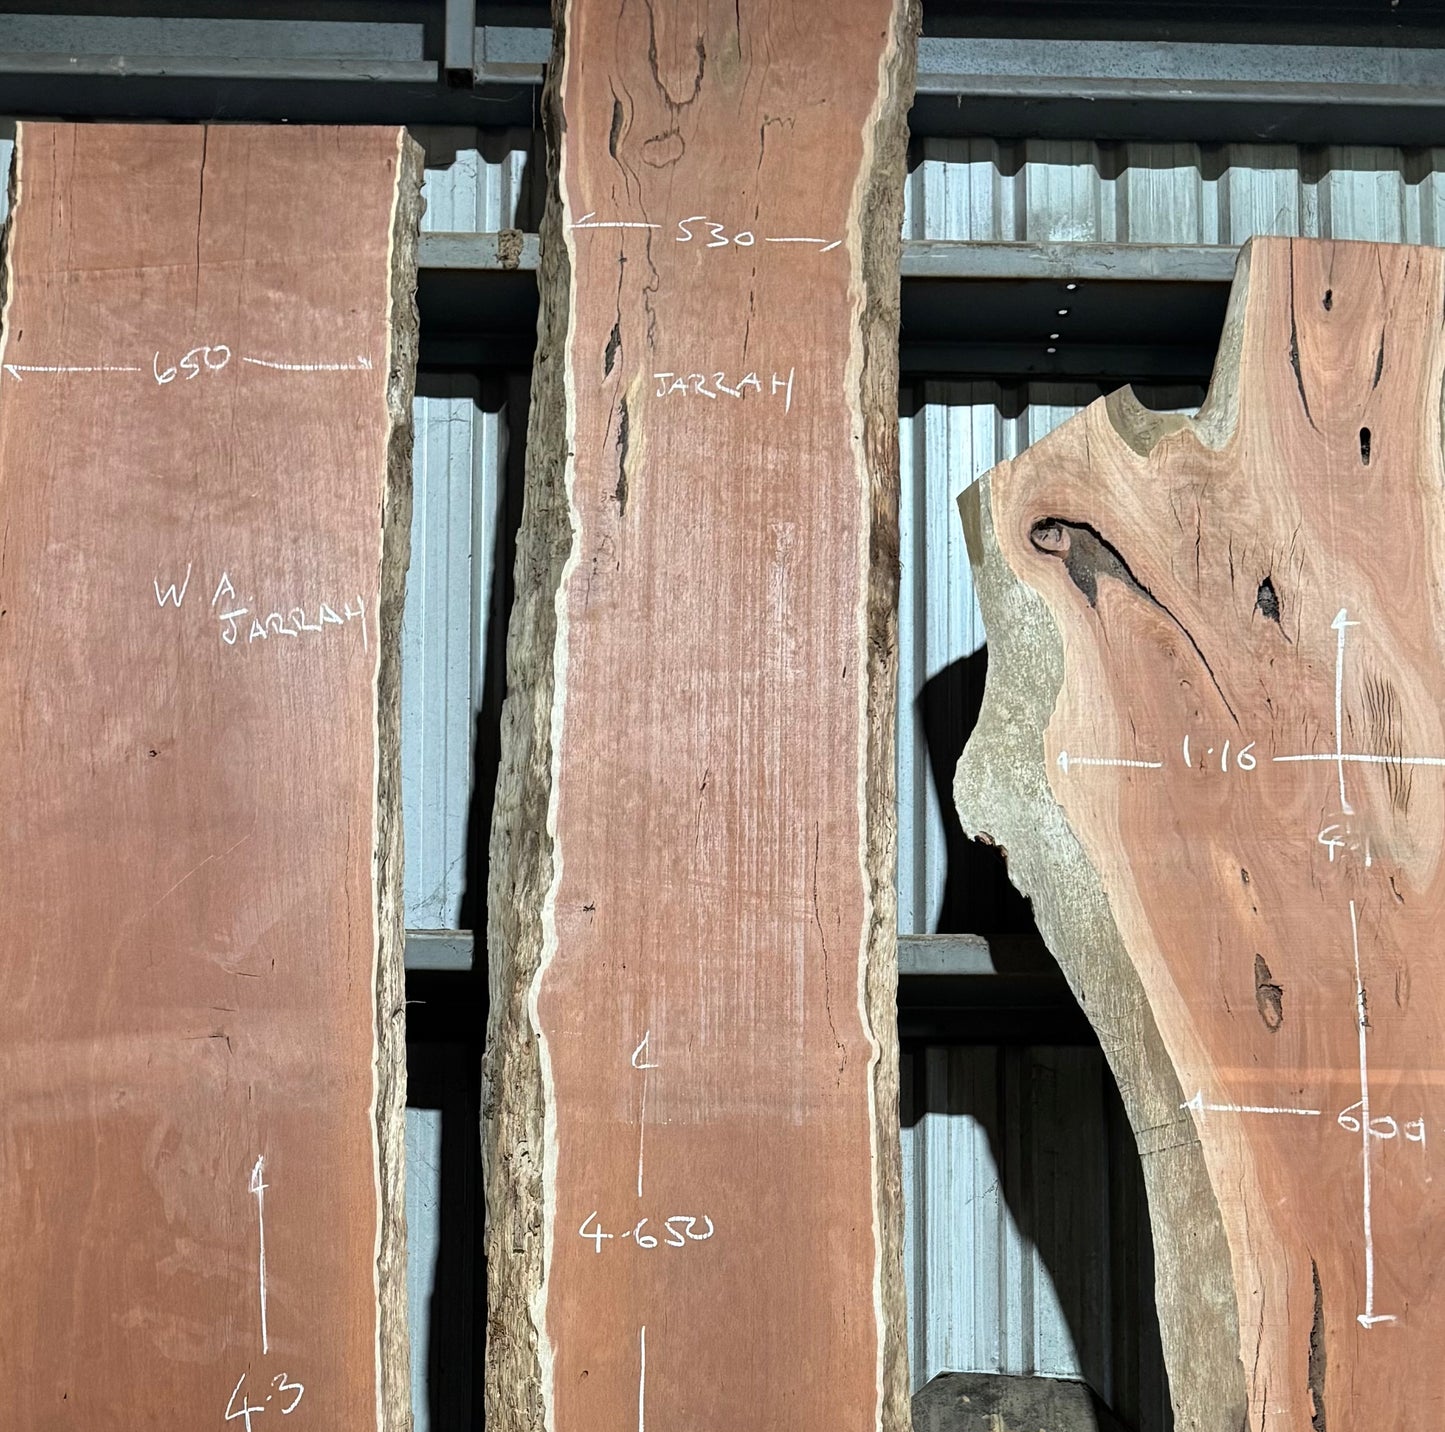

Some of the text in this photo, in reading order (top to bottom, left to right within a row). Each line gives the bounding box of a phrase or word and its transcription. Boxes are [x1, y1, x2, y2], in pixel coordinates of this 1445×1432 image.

[675, 216, 755, 248] 530
[152, 344, 232, 386] 650
[653, 366, 796, 415] JARRAH
[219, 594, 368, 655] JARRAH
